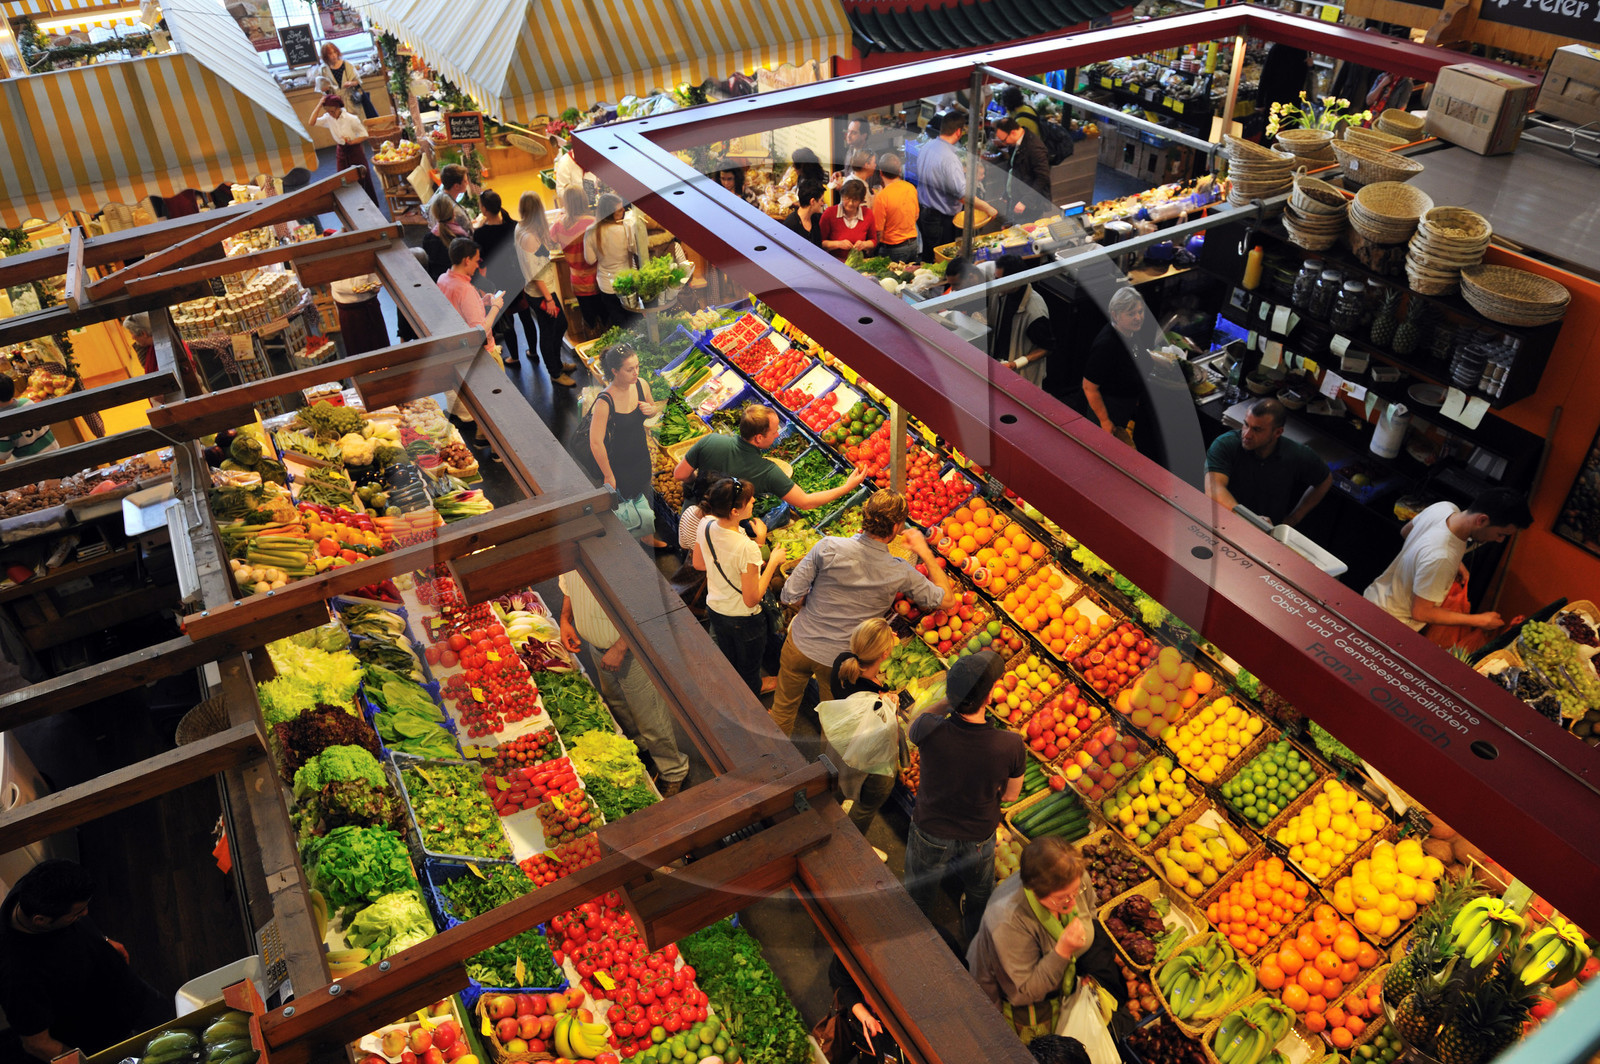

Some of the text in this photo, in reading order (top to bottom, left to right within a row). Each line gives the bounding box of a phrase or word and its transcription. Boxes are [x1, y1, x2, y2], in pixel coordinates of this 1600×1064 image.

[1187, 525, 1253, 569] Stand 90/91
[1259, 573, 1481, 726] Asiatische und Lateinamerikanische
[1270, 594, 1470, 735] Obst- und Gemüsespezialitäten
[1305, 642, 1452, 749] Franz Olbrich
